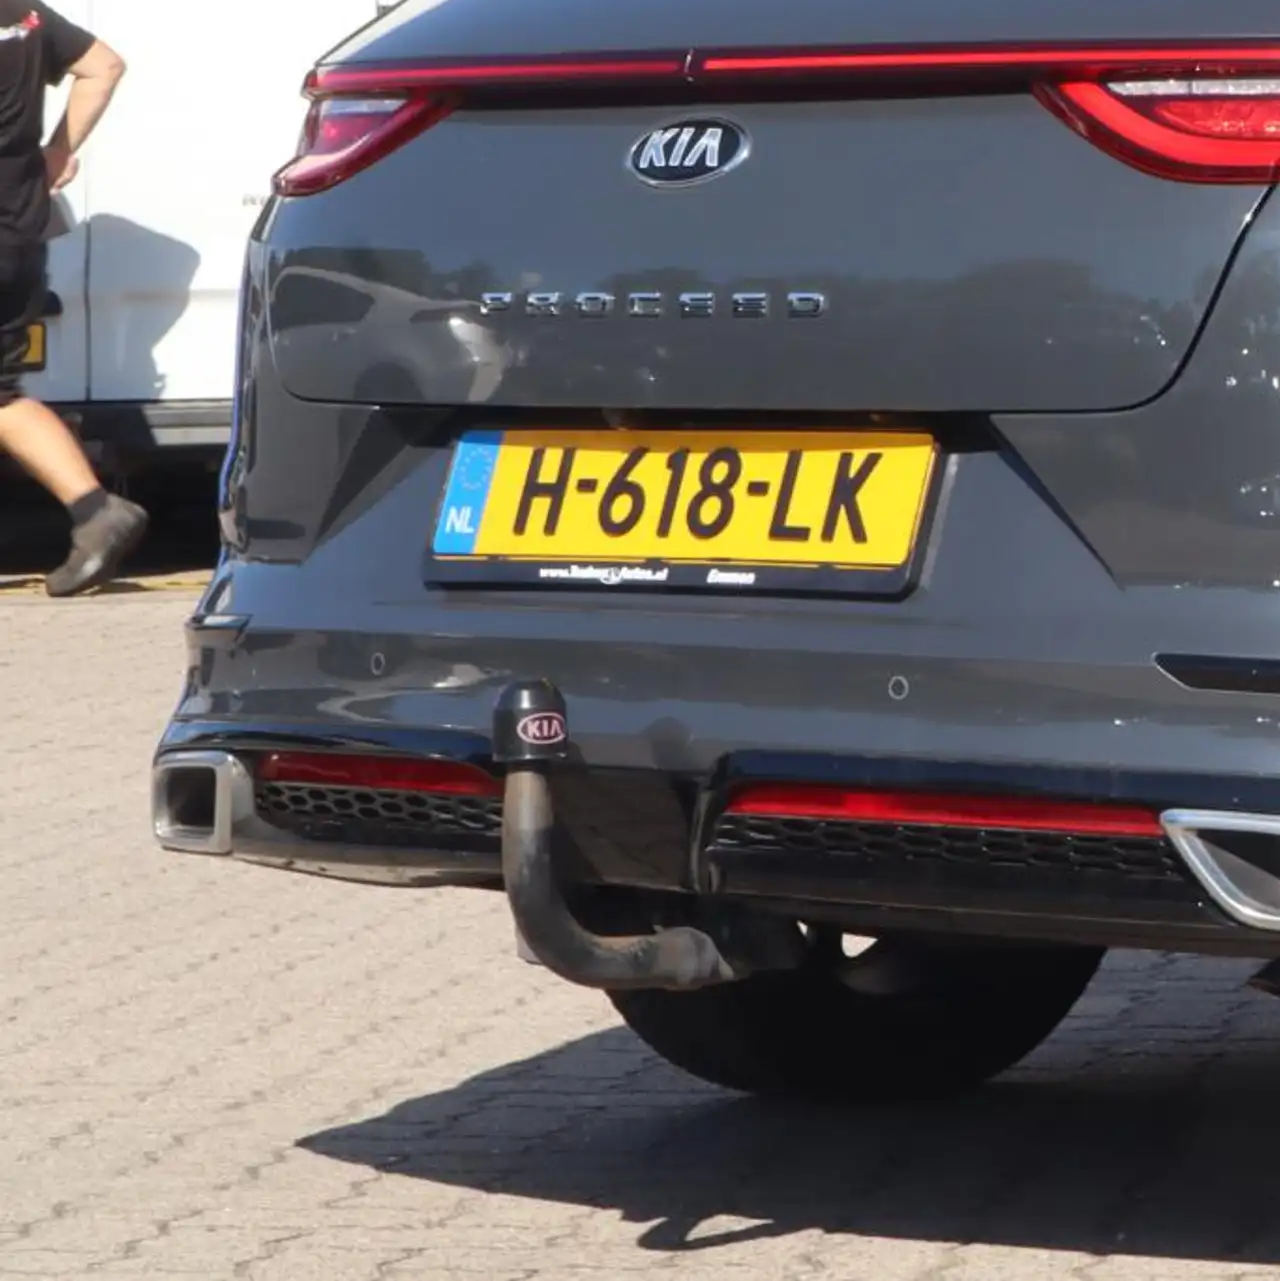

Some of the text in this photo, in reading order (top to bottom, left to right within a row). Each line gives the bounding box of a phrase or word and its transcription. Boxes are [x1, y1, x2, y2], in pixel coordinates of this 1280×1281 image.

[638, 126, 723, 169] KIA
[479, 291, 828, 319] PROCEED
[444, 445, 884, 545] NL H-618-LK
[526, 719, 561, 738] KIA
